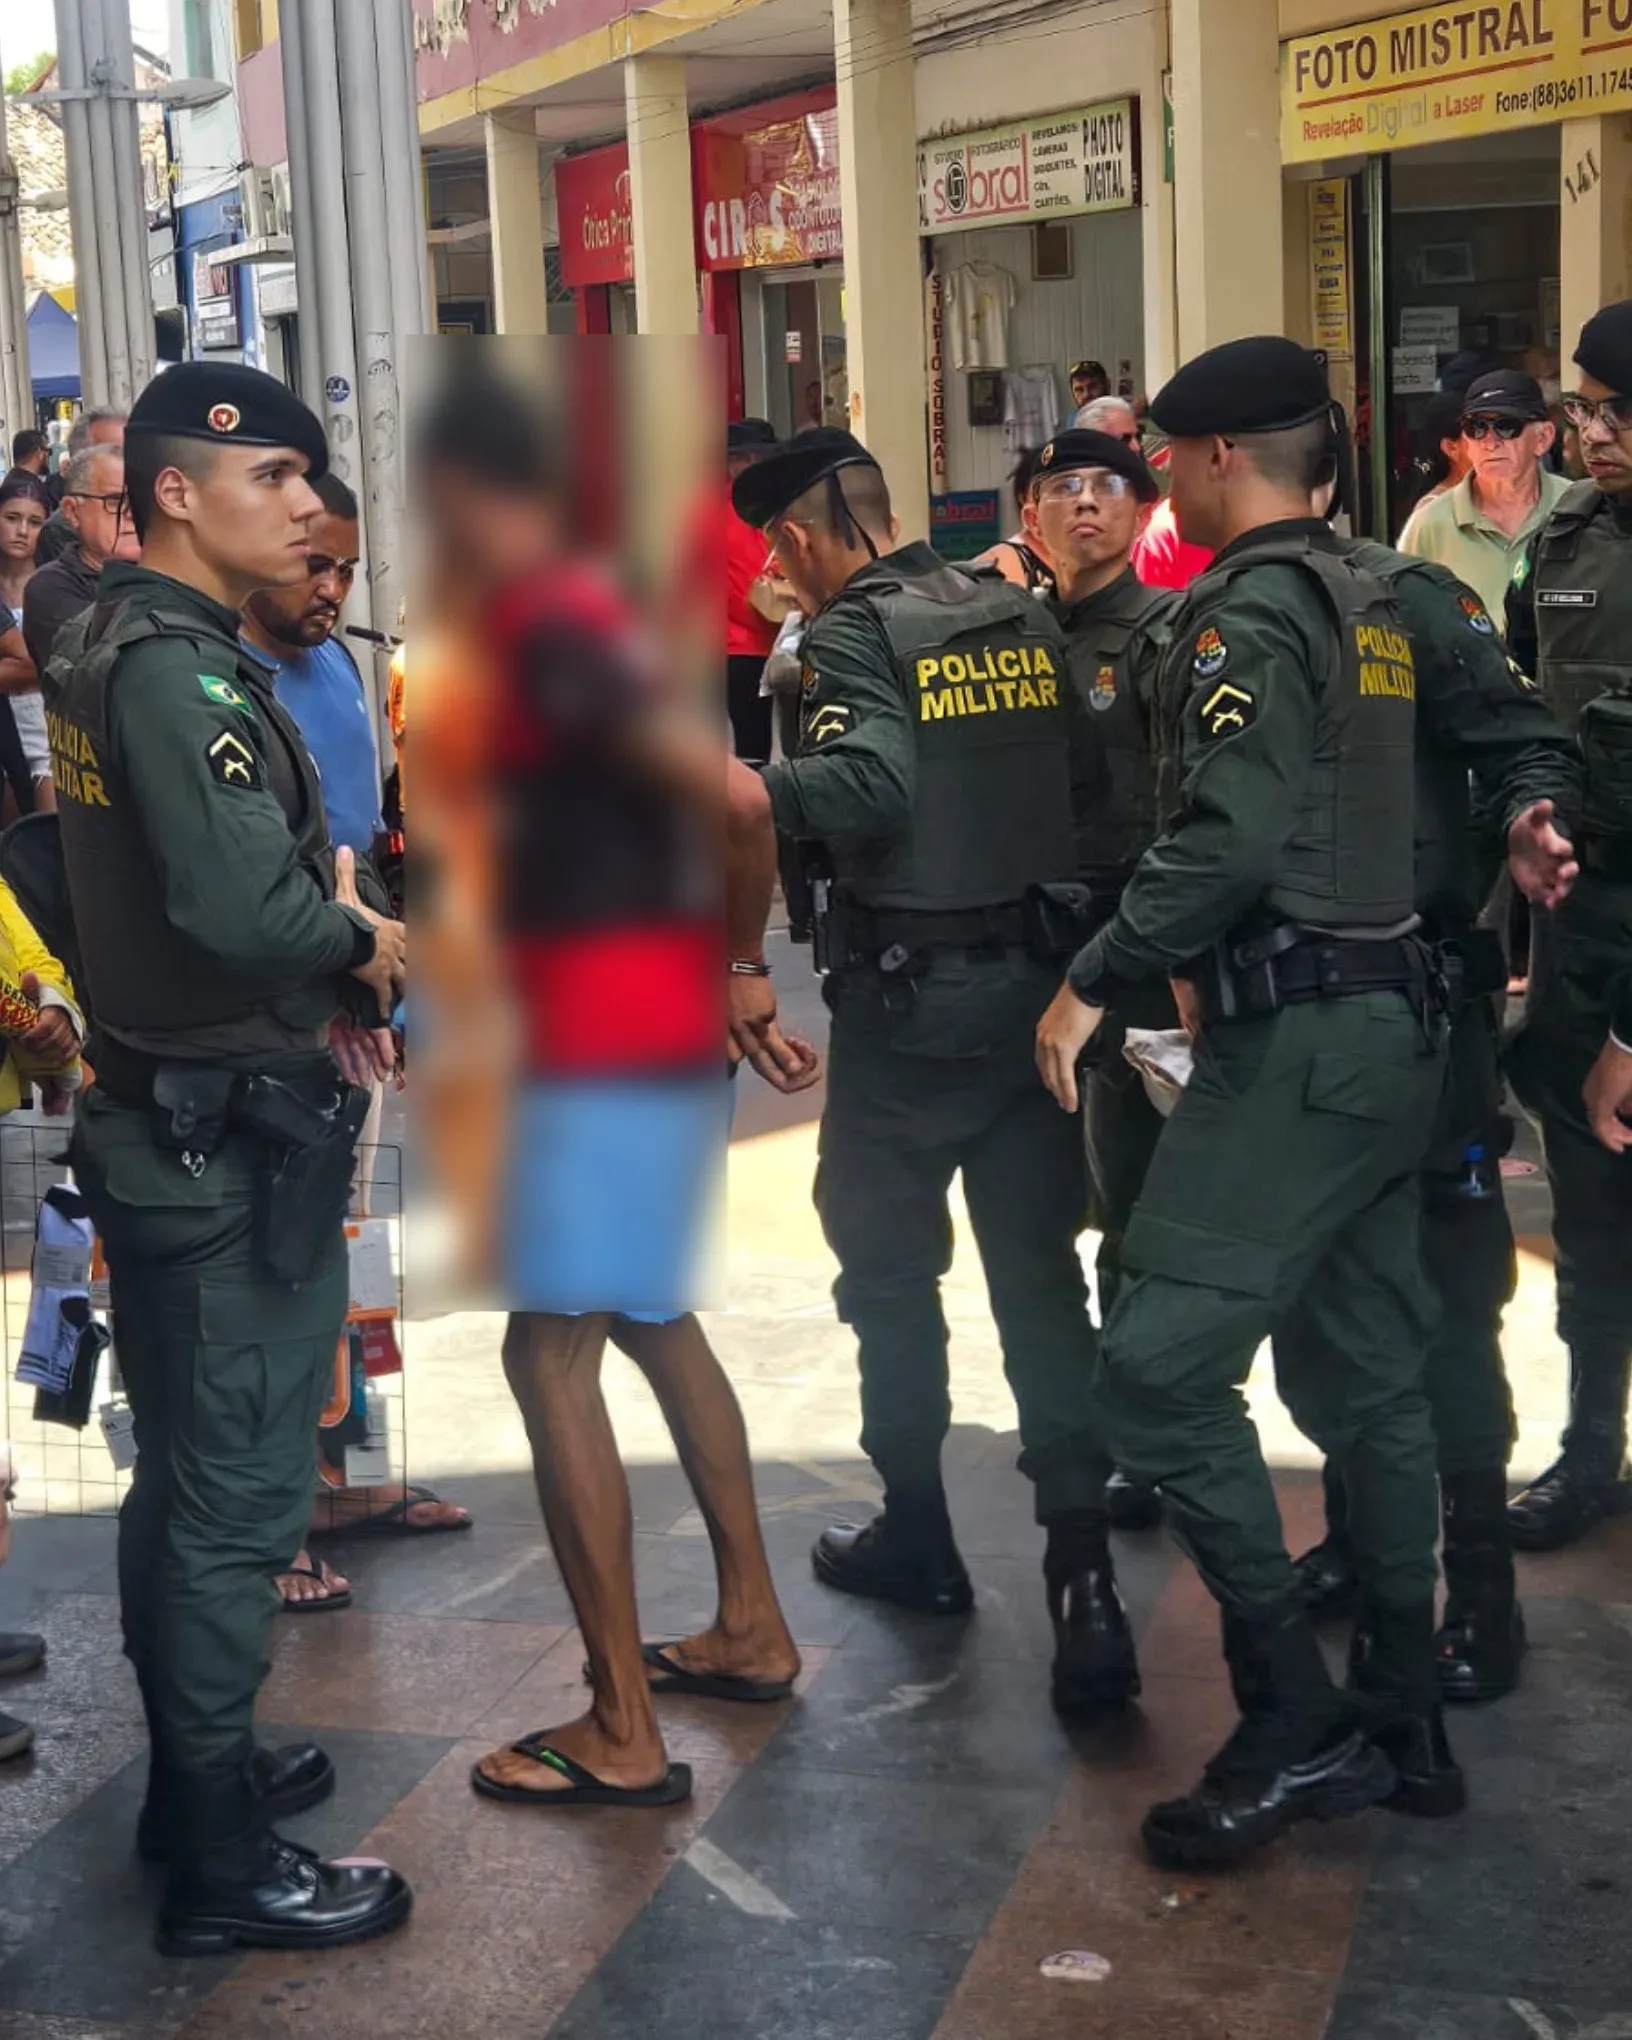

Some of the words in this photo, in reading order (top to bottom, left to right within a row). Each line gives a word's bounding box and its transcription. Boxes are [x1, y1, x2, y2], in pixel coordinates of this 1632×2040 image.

[1296, 35, 1377, 92] FOTO
[1390, 0, 1553, 75] MISTRAL
[1083, 111, 1123, 157] PHOTO
[1303, 113, 1363, 142] Revelação
[1367, 92, 1427, 140] Digital
[1433, 102, 1441, 118] a
[1445, 93, 1484, 117] Laser
[1085, 160, 1124, 203] DIGITAL
[933, 378, 946, 475] SOBRAL
[916, 645, 1056, 688] POLÍCIA
[920, 678, 1060, 721] MILITAR
